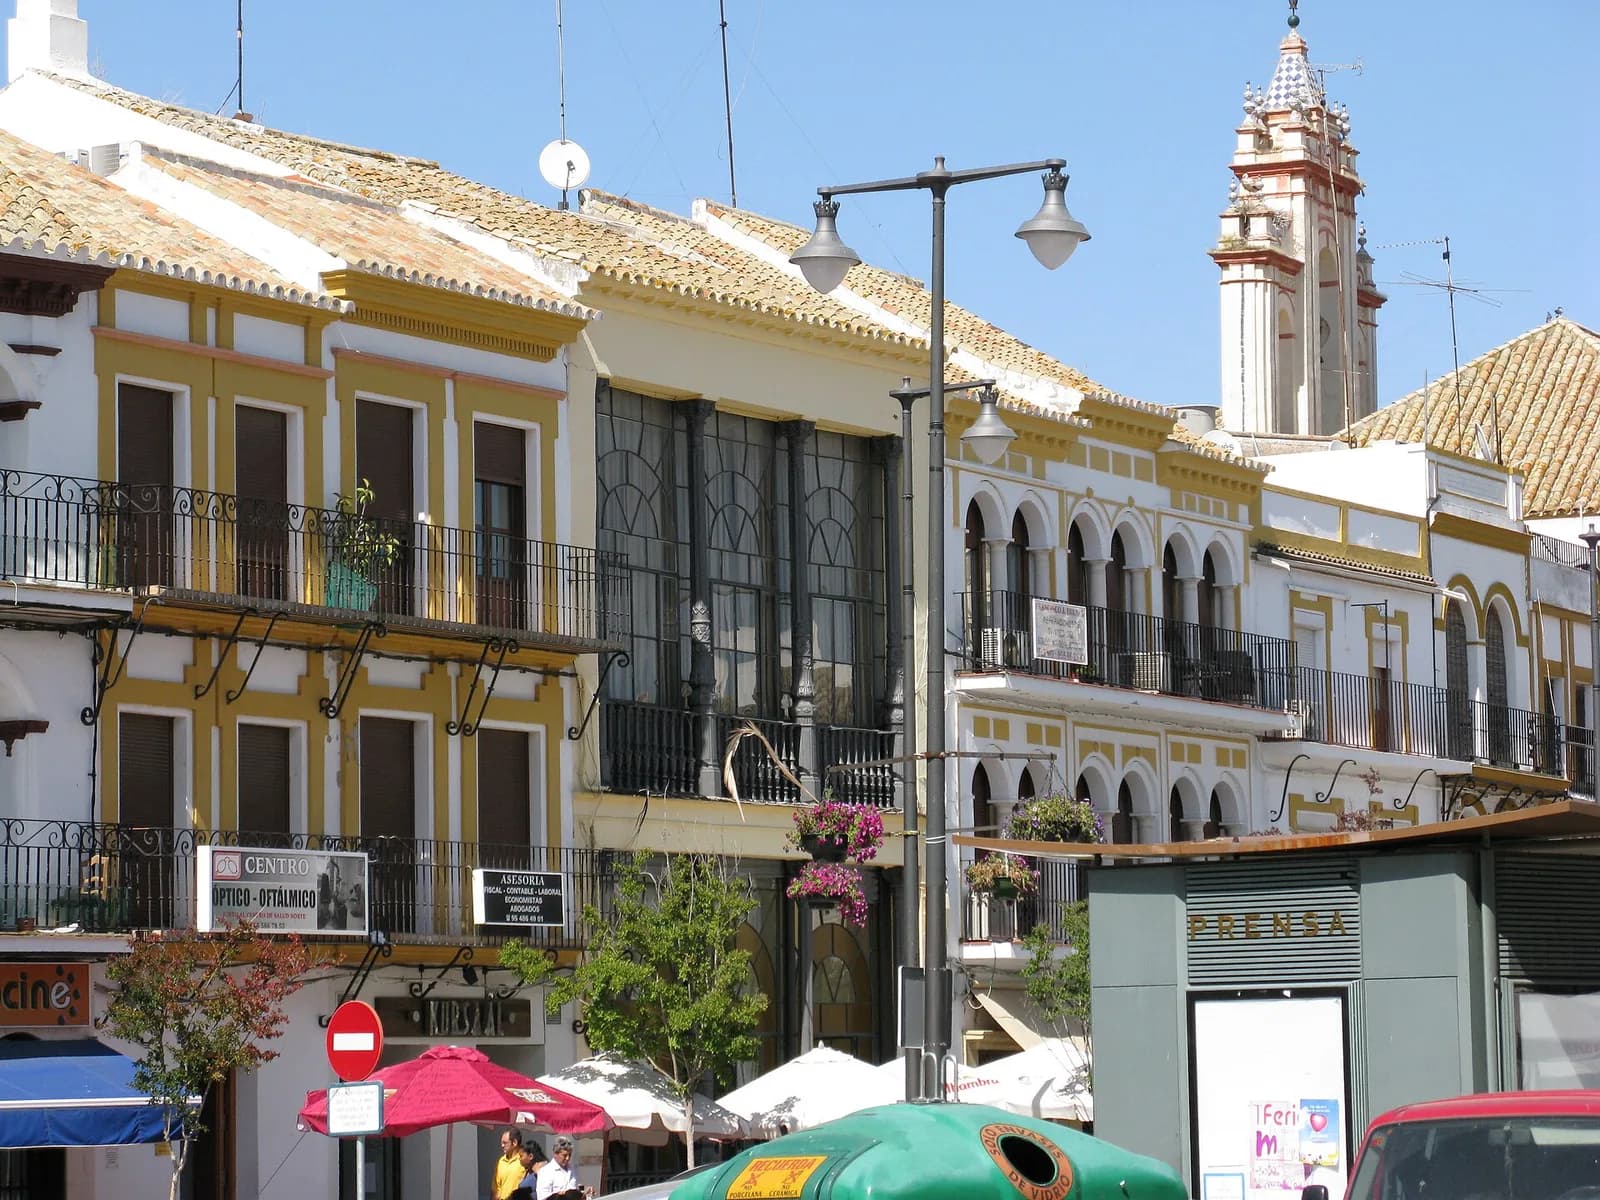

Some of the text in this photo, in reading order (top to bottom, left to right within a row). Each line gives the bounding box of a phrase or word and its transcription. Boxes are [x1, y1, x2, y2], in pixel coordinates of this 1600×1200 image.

[244, 856, 310, 876] CENTRO
[500, 875, 545, 886] ASESORIA
[212, 884, 251, 908] ÓPTICO
[259, 885, 316, 909] OFTÁLMICO
[506, 887, 534, 895] CONTABLE
[538, 888, 562, 896] LABORAL
[504, 896, 543, 904] ECONOMISTAS
[509, 905, 540, 913] ABOGADOS
[1189, 908, 1347, 941] PRENSA
[430, 1000, 505, 1037] KURSAAL
[749, 1158, 817, 1171] RECUERDA
[1008, 1171, 1070, 1200] DE VIDRIO
[729, 1191, 762, 1199] PORCELANA
